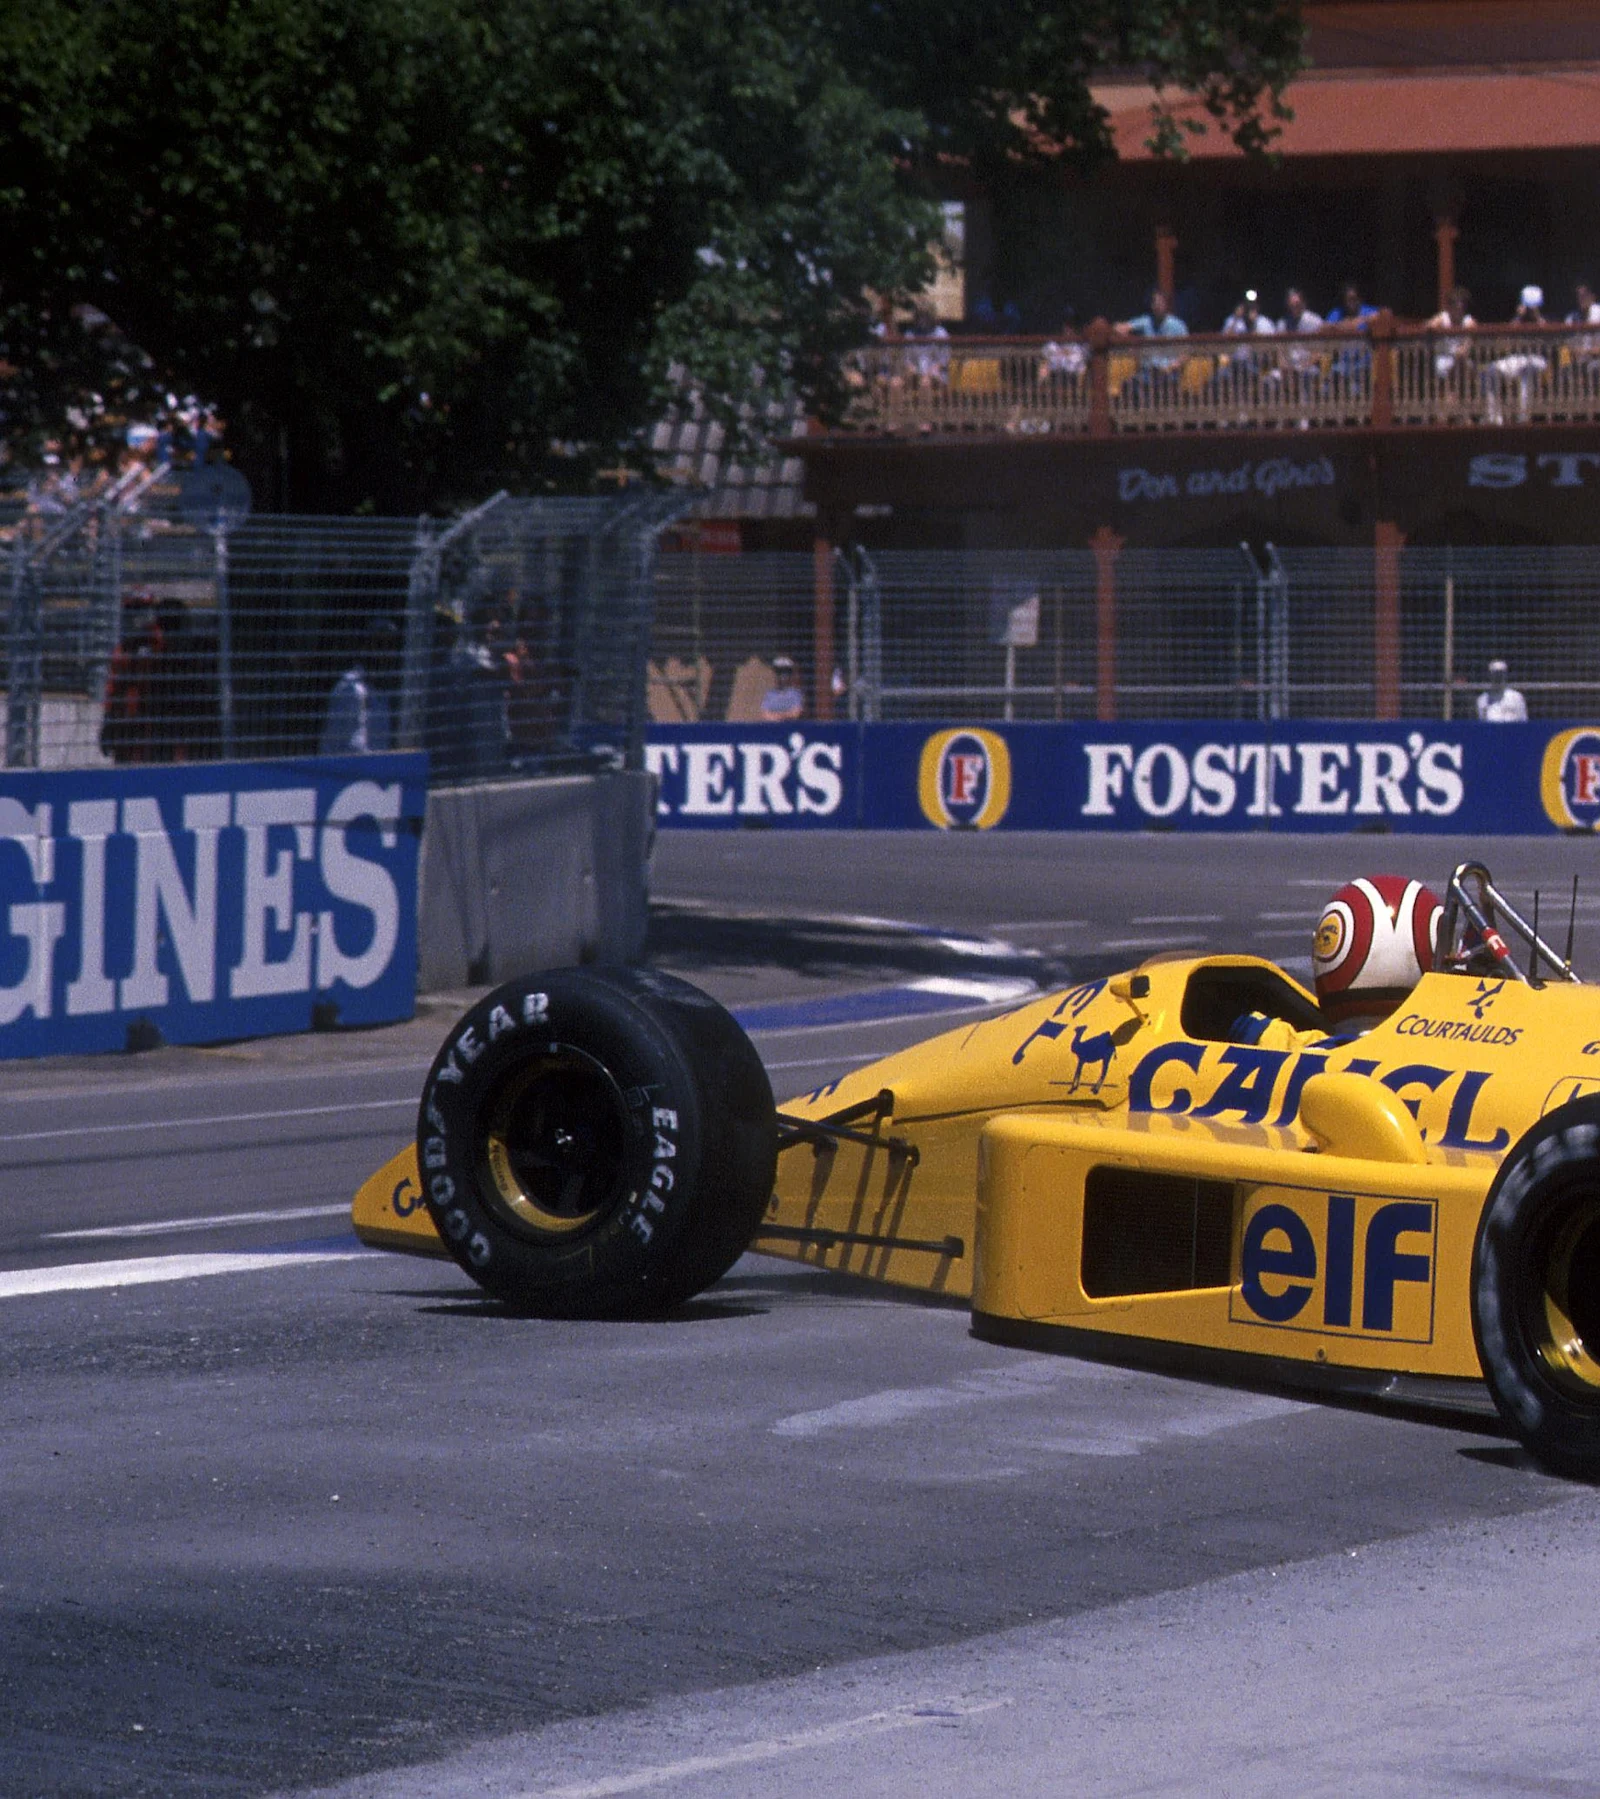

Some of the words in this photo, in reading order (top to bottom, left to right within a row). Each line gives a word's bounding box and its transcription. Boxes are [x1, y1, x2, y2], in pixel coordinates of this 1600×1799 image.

[1119, 468, 1180, 502] Don
[1185, 460, 1251, 496] and
[1080, 731, 1463, 817] FOSTER'S
[1395, 1013, 1524, 1046] COURTAULDS
[631, 1107, 679, 1244] EAGLE
[1241, 1196, 1434, 1332] elf
